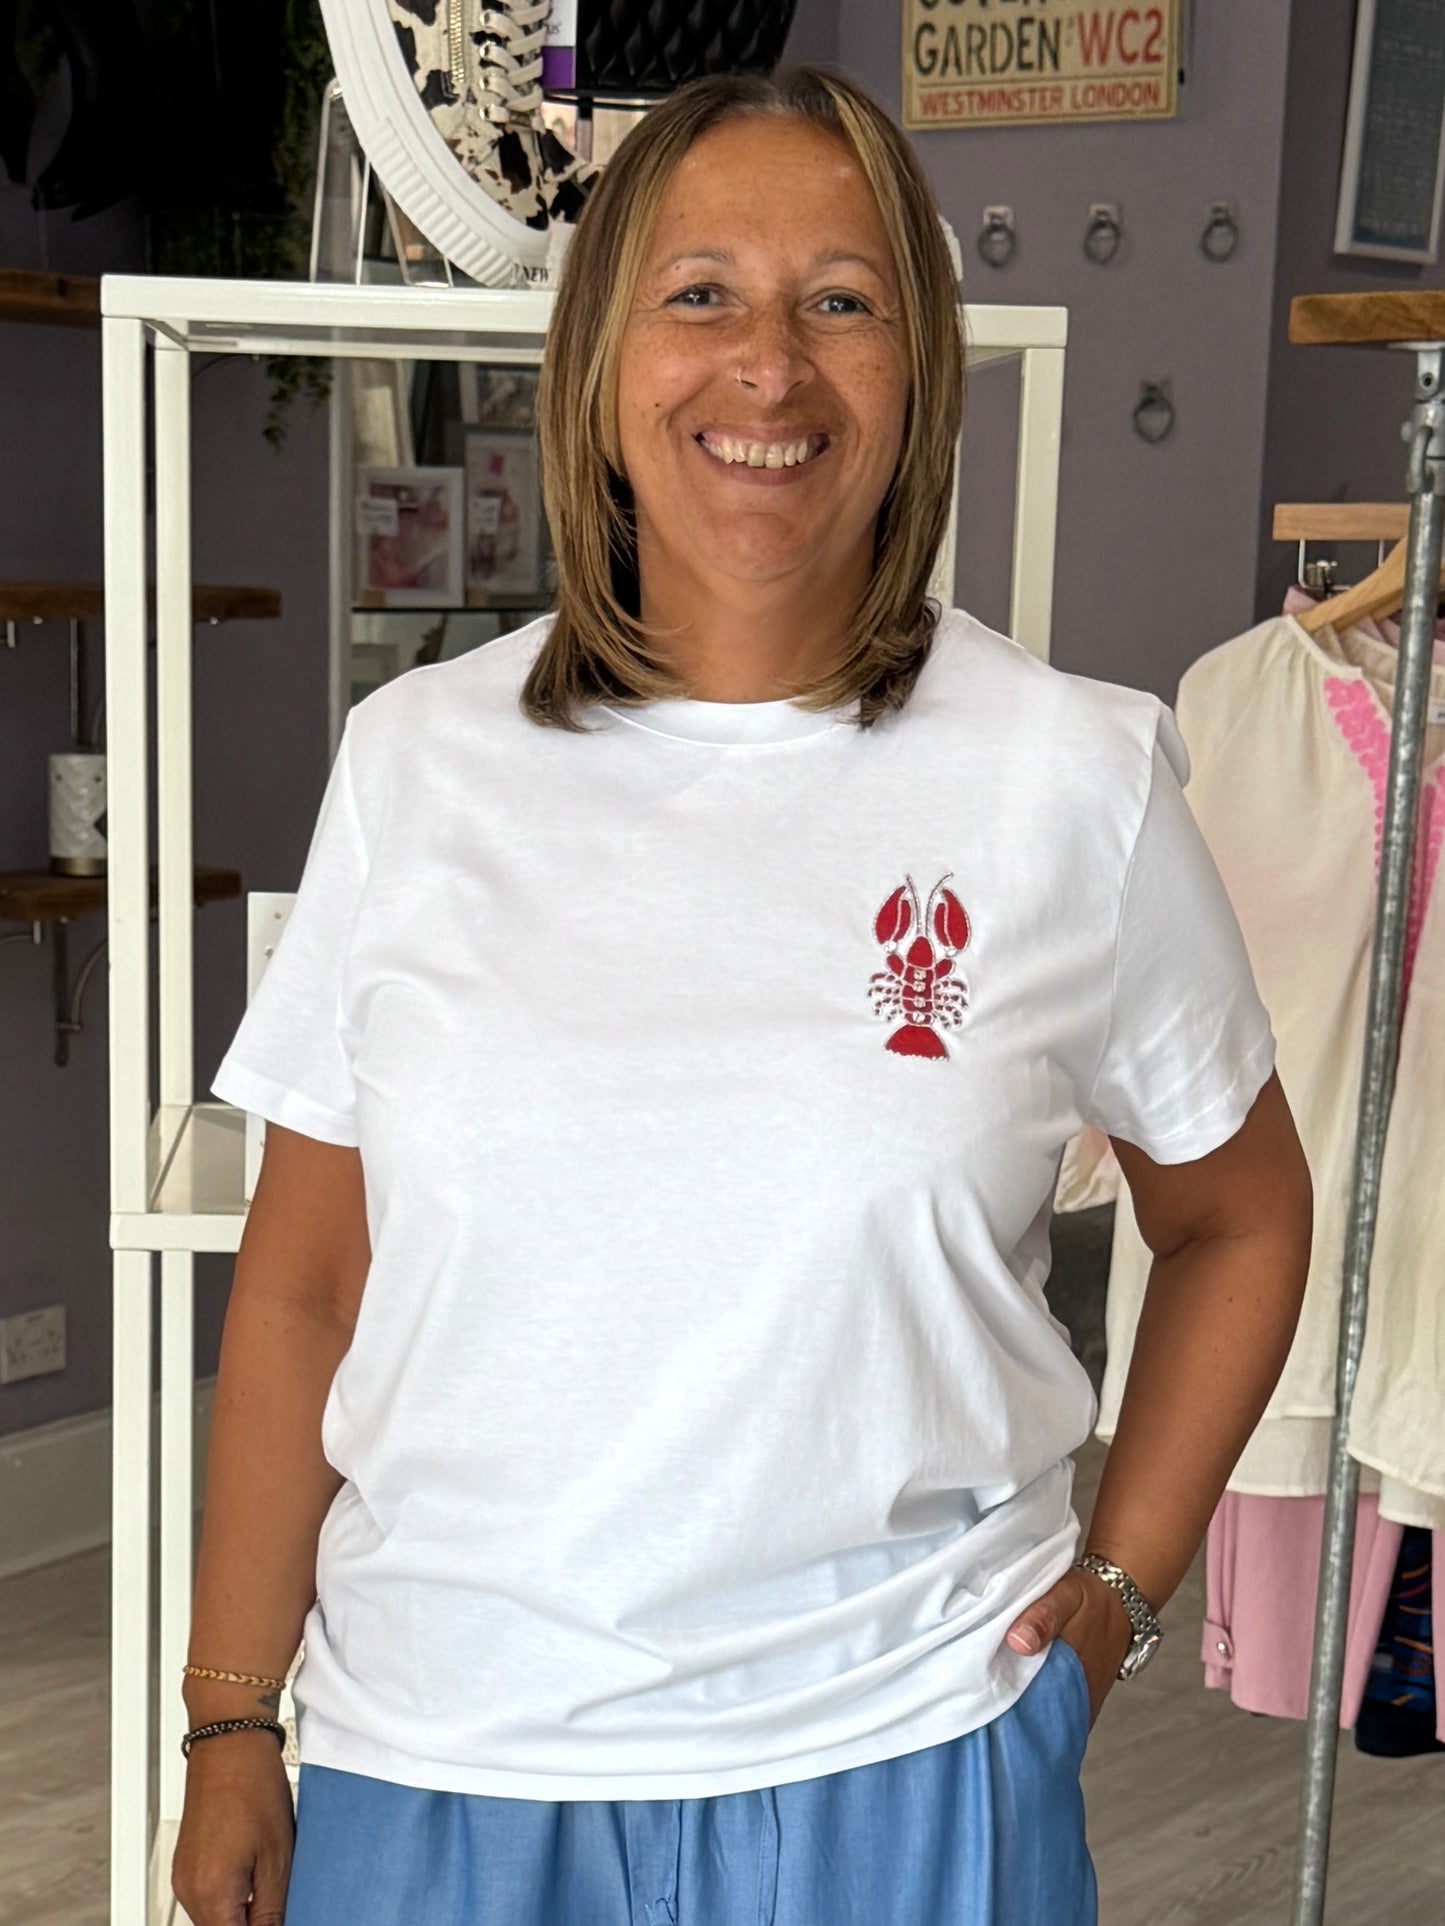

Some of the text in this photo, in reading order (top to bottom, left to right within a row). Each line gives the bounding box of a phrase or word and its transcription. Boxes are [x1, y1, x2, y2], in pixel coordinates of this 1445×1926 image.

[914, 8, 1164, 77] GARDEN WC2
[919, 81, 1160, 117] WESTMINSTER LONDON
